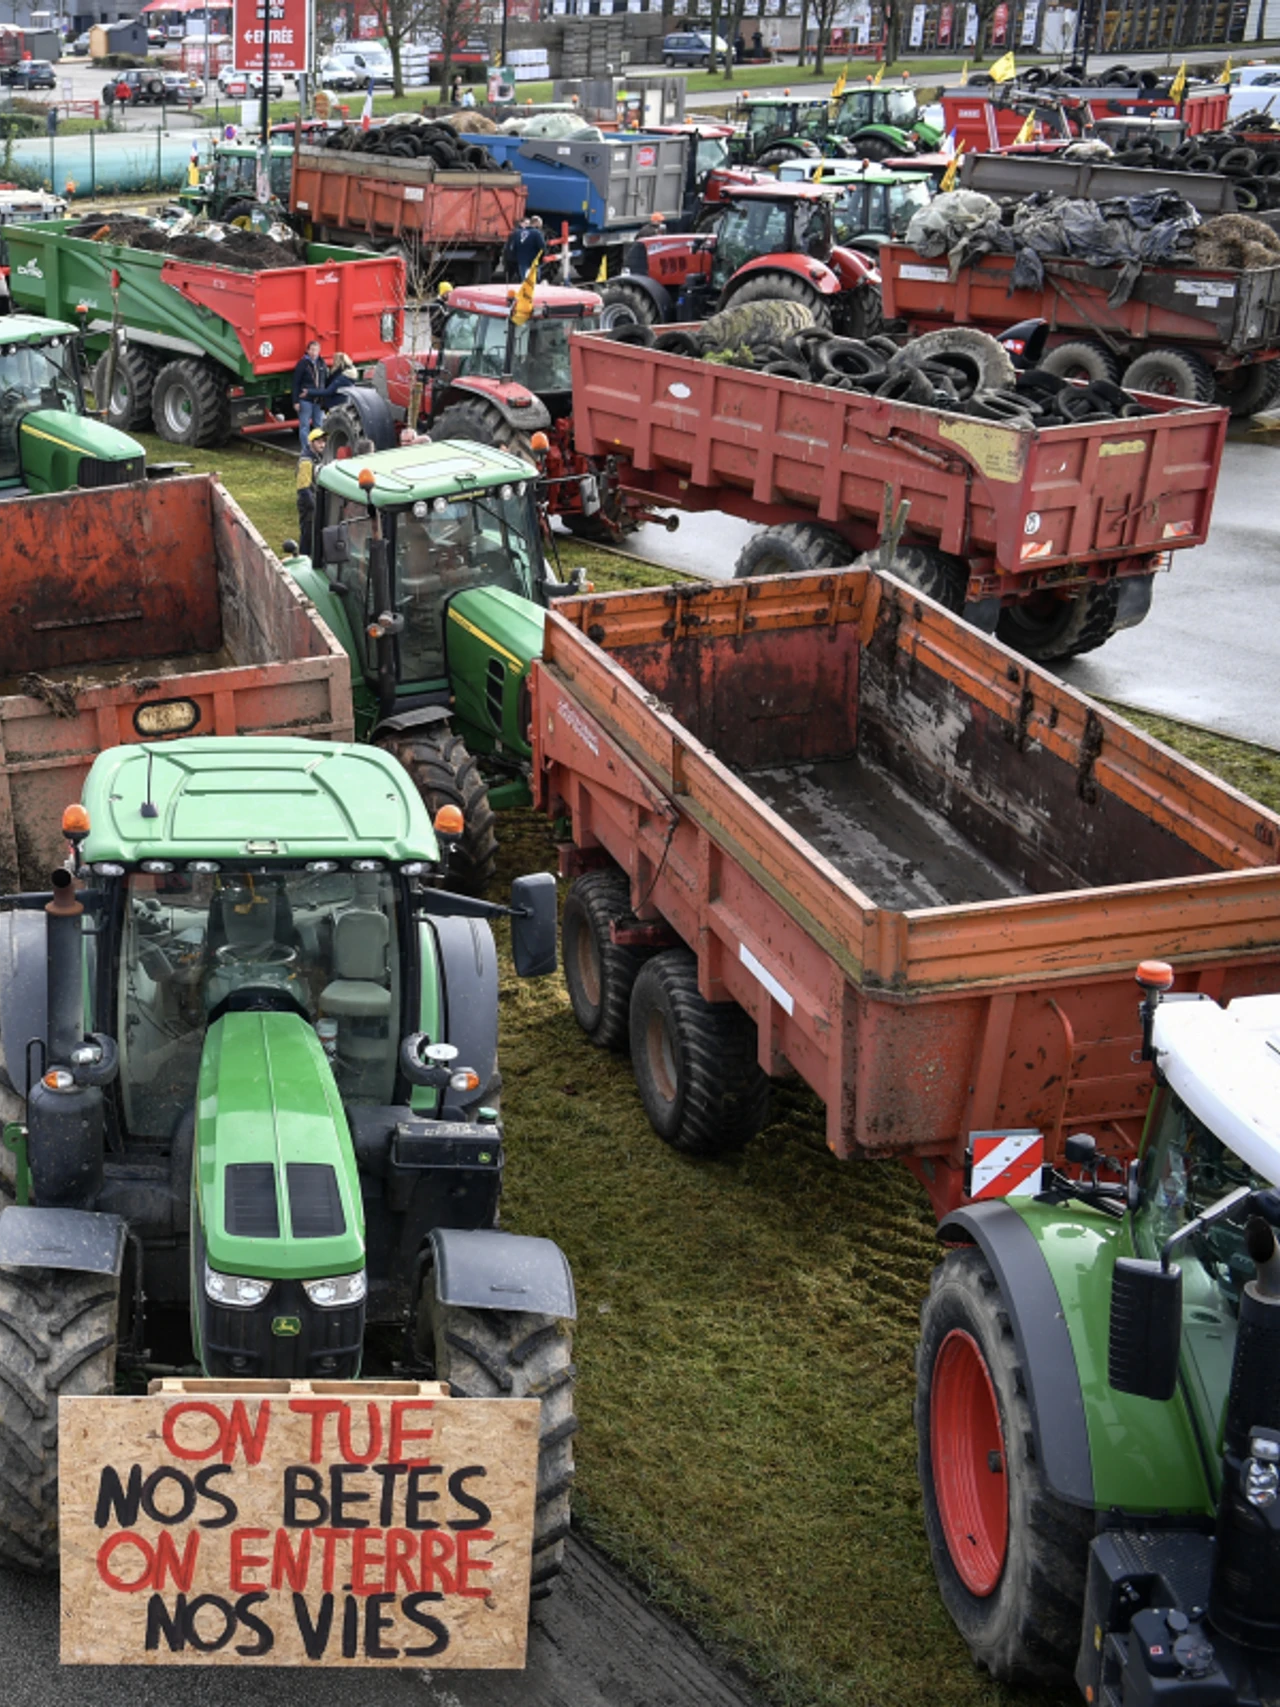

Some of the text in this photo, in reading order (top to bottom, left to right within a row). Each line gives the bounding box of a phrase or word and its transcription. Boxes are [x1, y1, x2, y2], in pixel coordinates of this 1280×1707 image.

[161, 1399, 435, 1468] ON TUE
[94, 1463, 493, 1531] NOS BETES
[95, 1528, 495, 1599] ON ENTERRE
[143, 1592, 275, 1654] NOS
